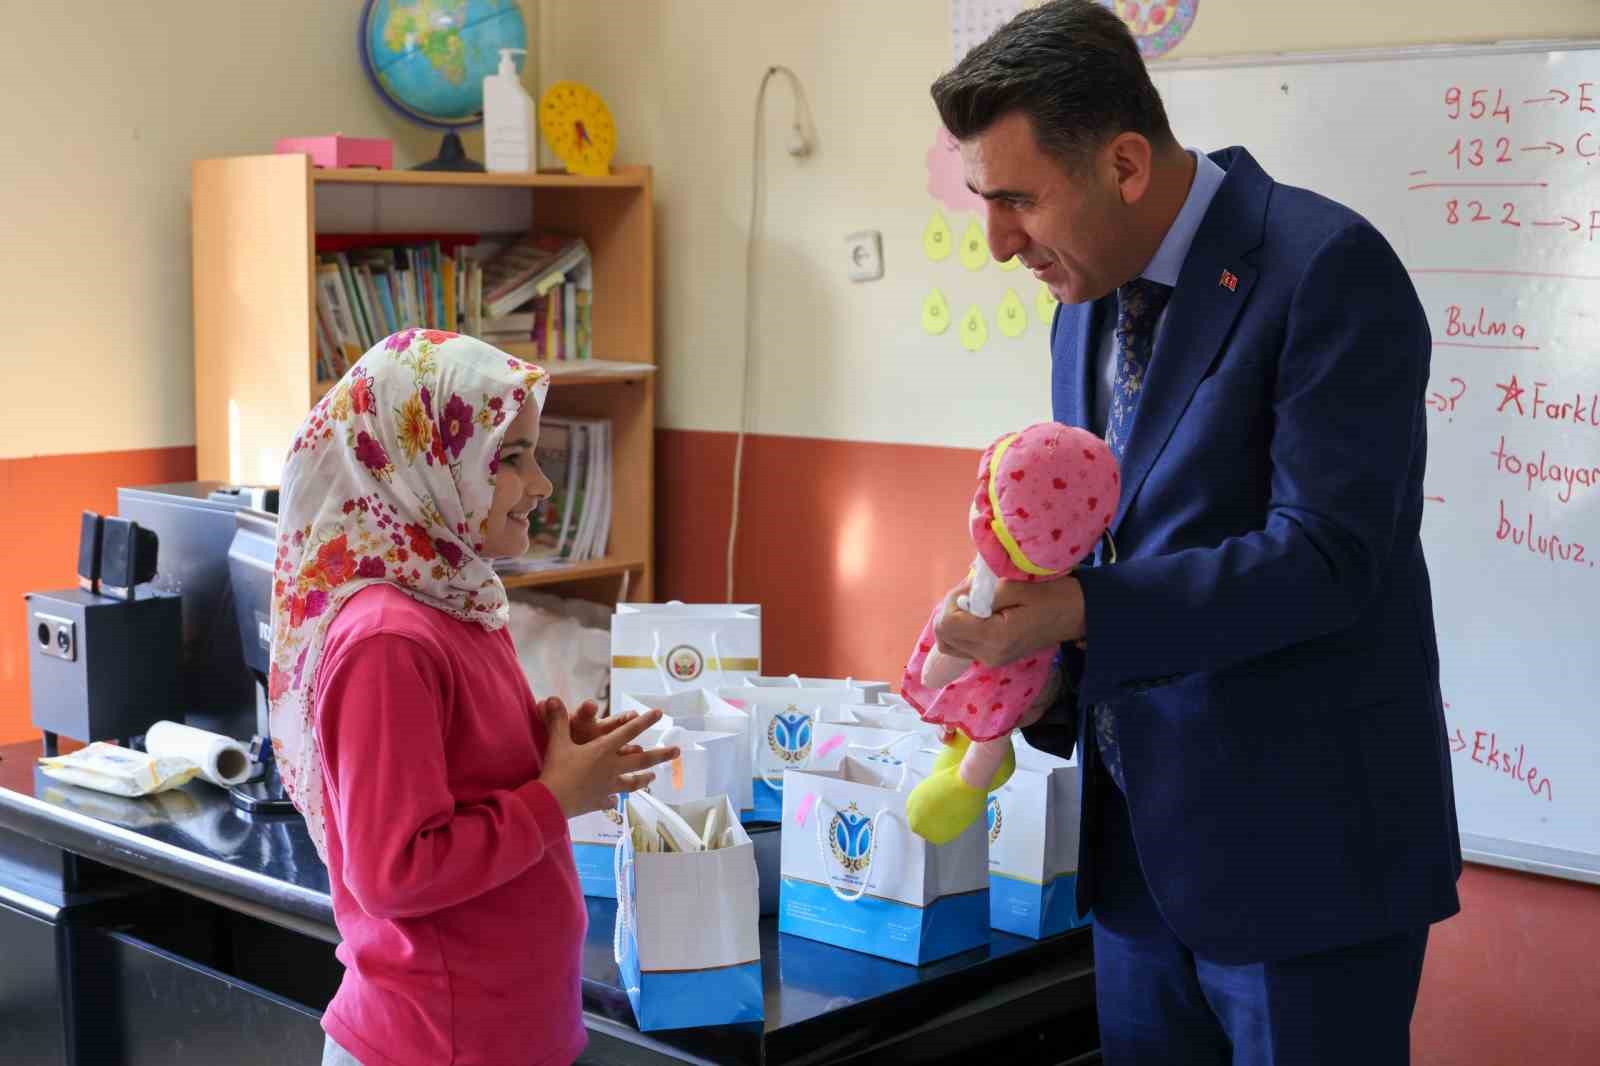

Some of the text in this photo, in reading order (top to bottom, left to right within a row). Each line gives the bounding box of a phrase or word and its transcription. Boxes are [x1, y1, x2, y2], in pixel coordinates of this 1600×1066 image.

[1445, 87, 1510, 124] 954
[1447, 131, 1600, 170] 132 Ç
[1446, 199, 1521, 227] 822
[1446, 305, 1525, 339] Bulma
[1496, 499, 1594, 567] buluruz.
[1472, 731, 1552, 802] Eksilen
